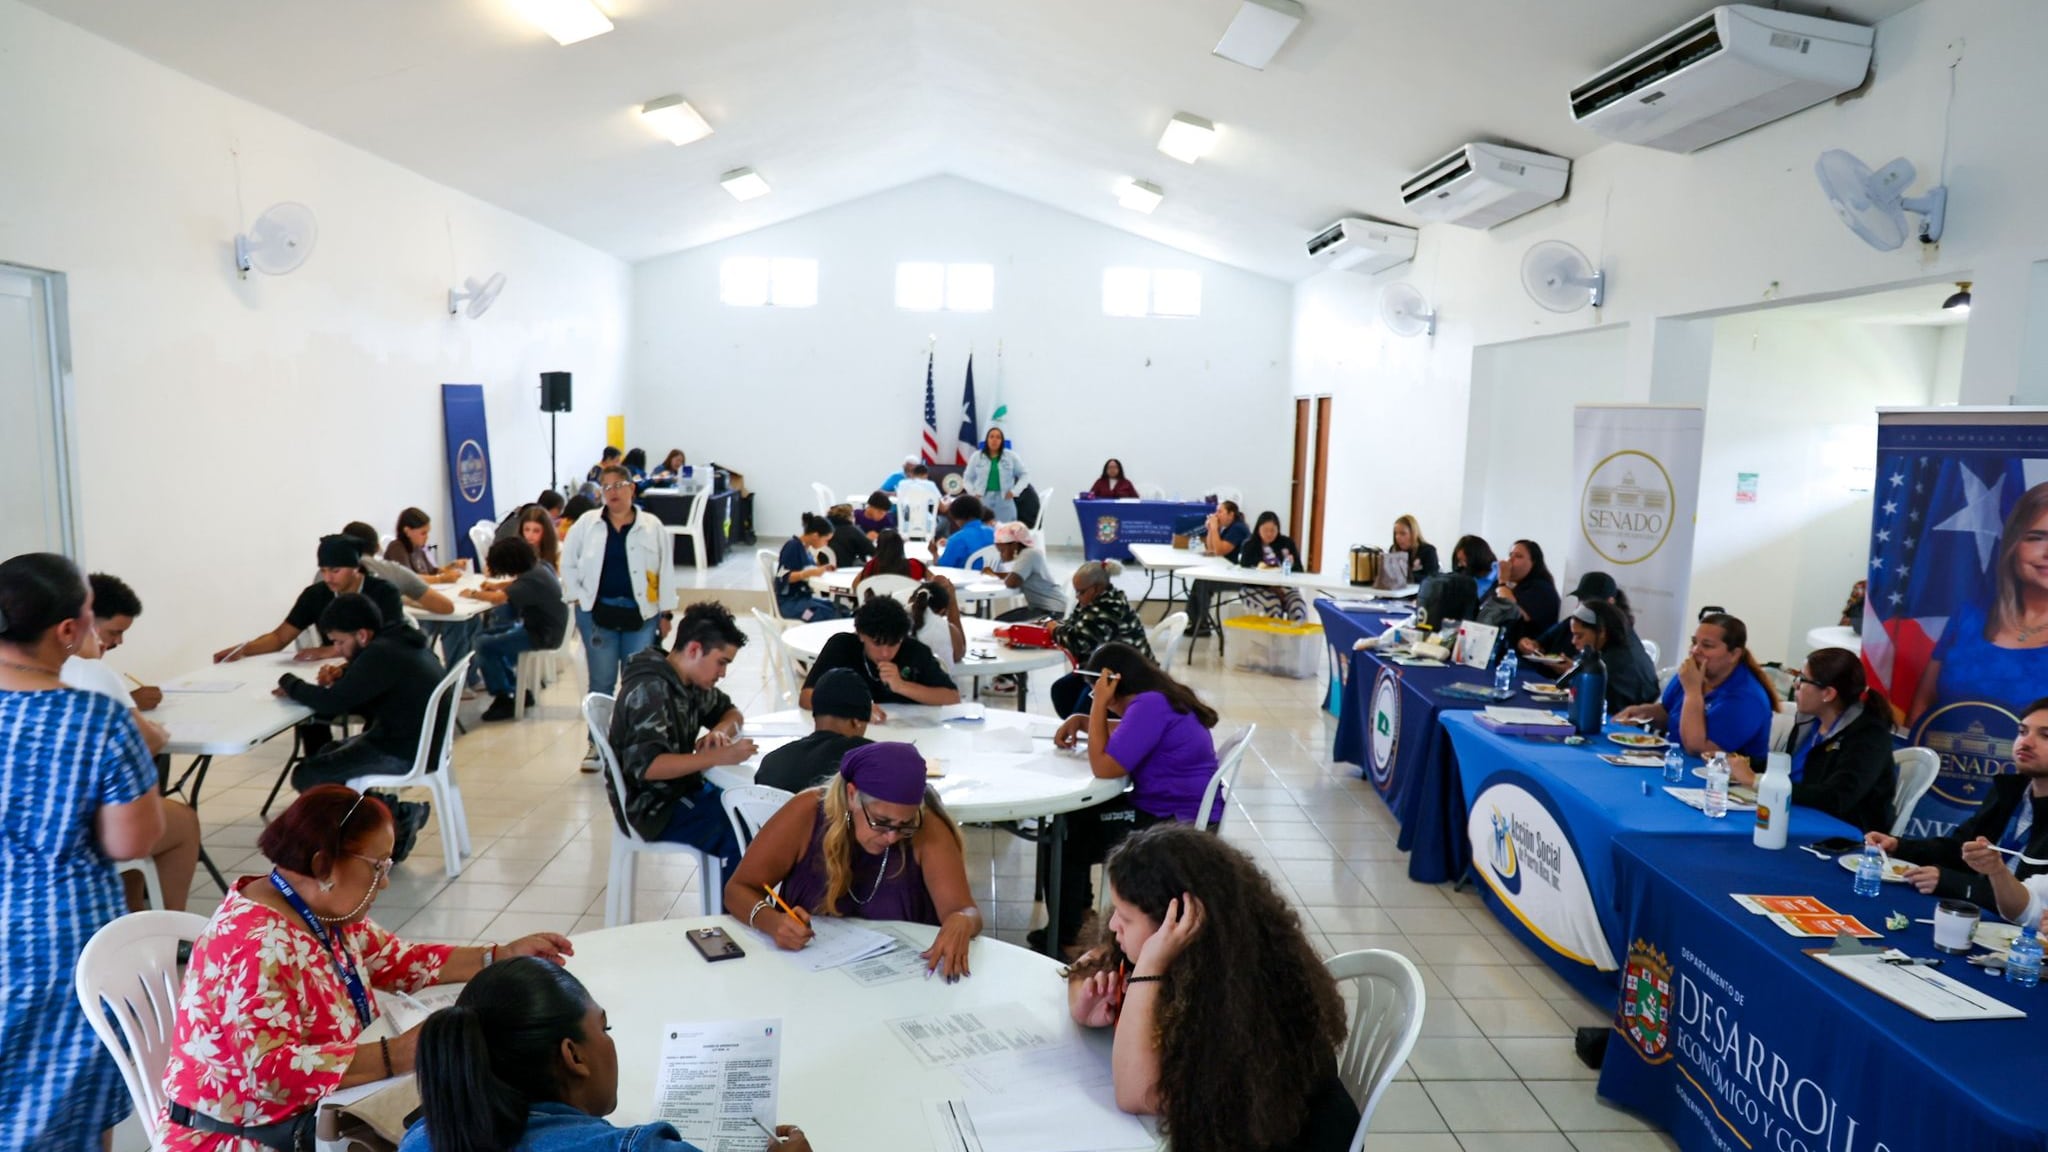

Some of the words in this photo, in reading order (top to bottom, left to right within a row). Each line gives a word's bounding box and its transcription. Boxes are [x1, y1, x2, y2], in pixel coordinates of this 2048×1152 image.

[1588, 509, 1663, 534] SENADO
[1939, 752, 2017, 776] ENADO
[1536, 831, 1561, 875] Social
[1681, 946, 1734, 997] DEPARTAMENTO
[1733, 990, 1745, 1007] DE
[1677, 1026, 1759, 1126] ECONÓMICO
[1762, 1111, 1775, 1138] Y
